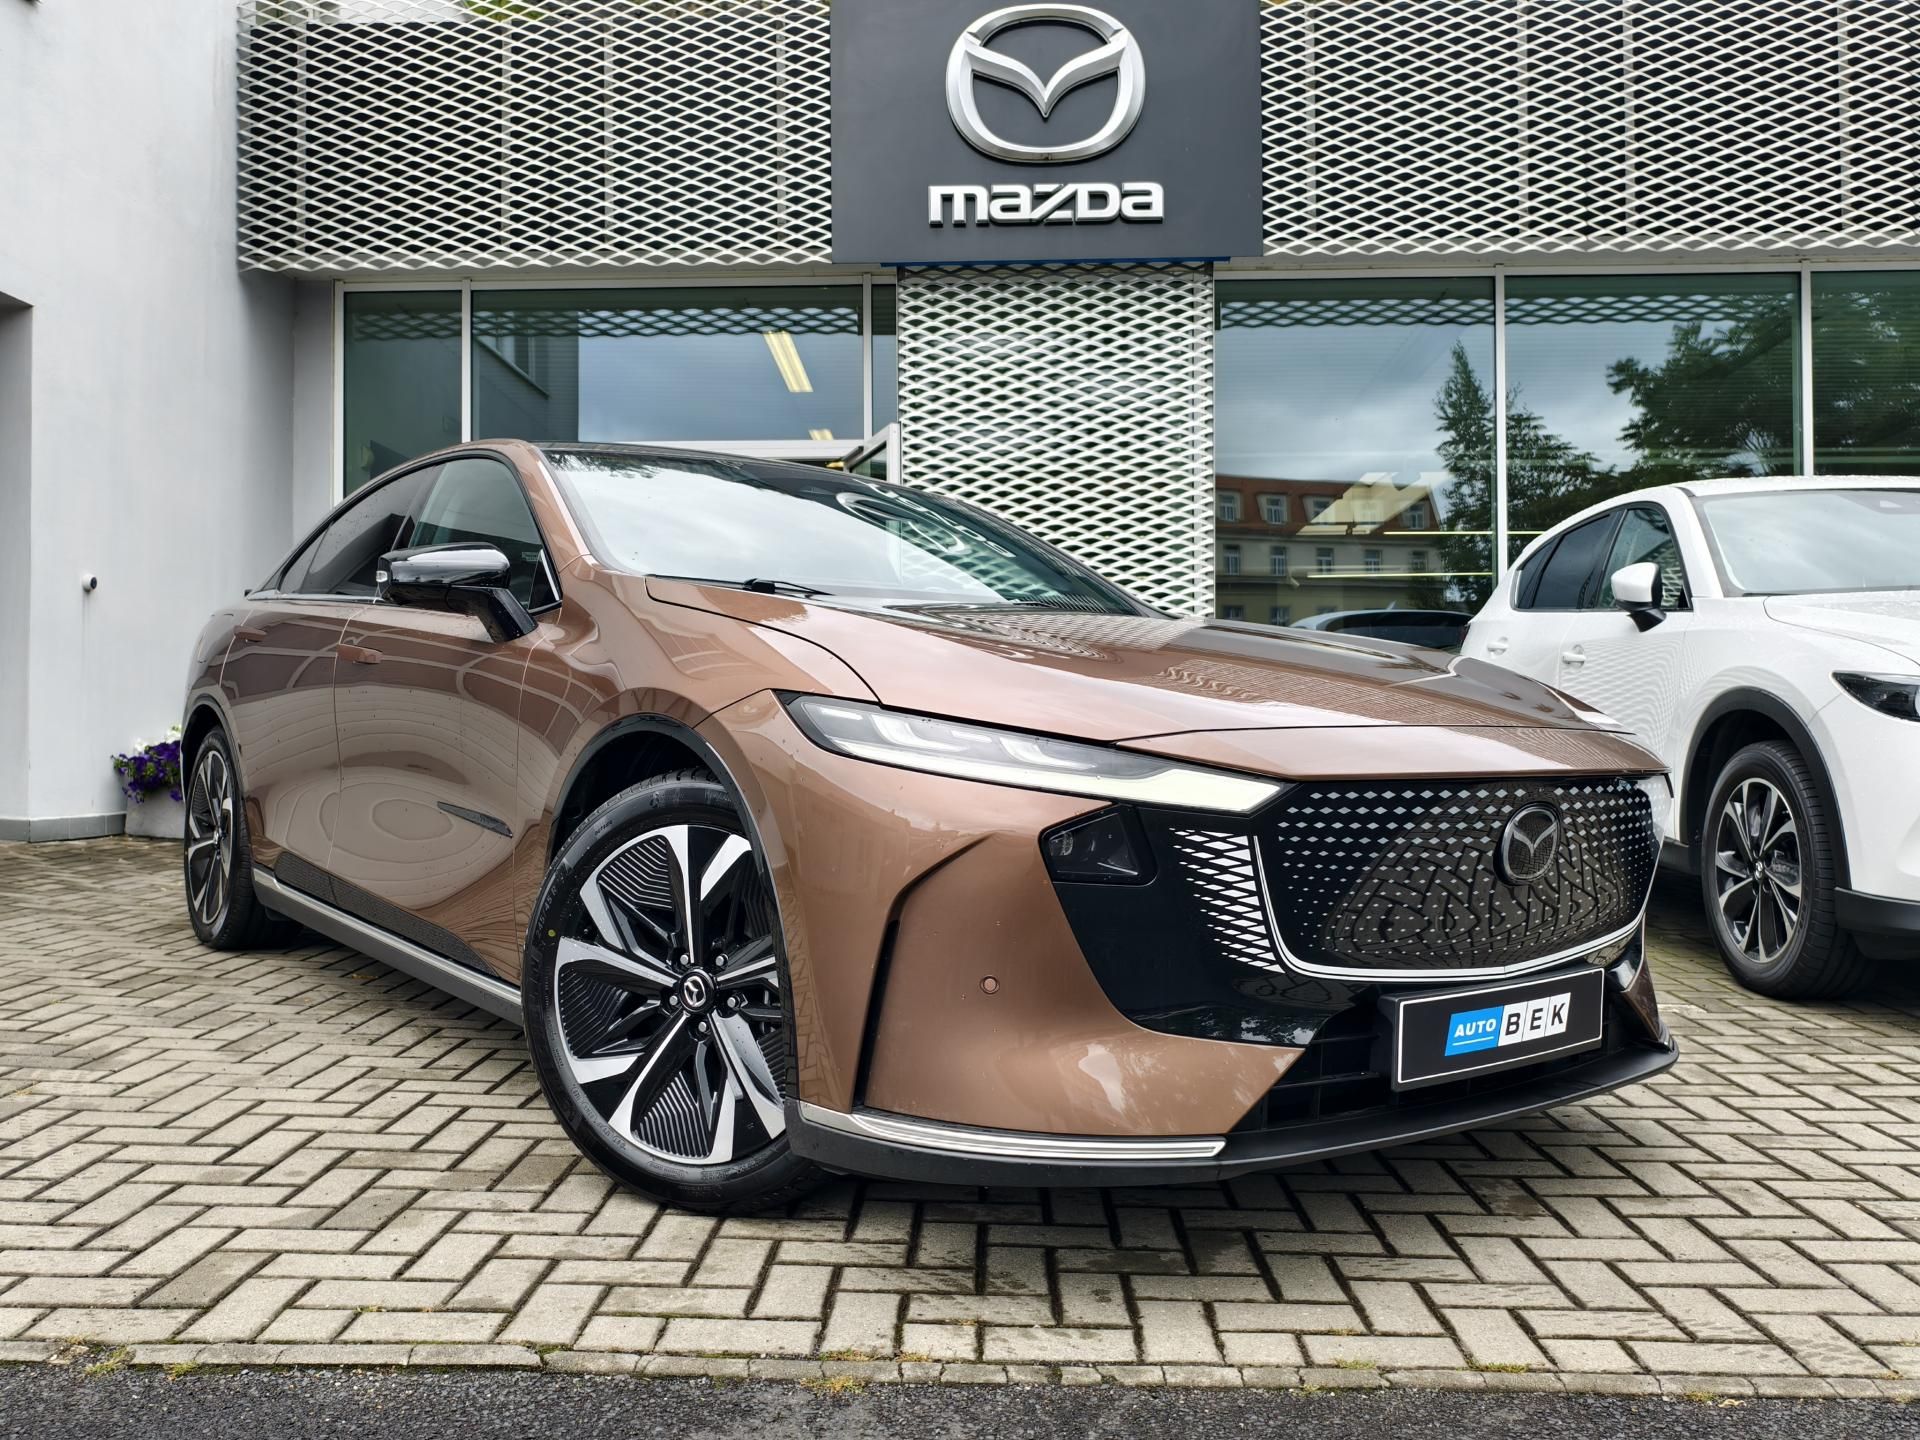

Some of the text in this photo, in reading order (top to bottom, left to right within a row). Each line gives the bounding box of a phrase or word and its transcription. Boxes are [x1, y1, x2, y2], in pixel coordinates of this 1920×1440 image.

[928, 182, 1165, 226] mazda
[1454, 1003, 1566, 1038] AUTO BEK
